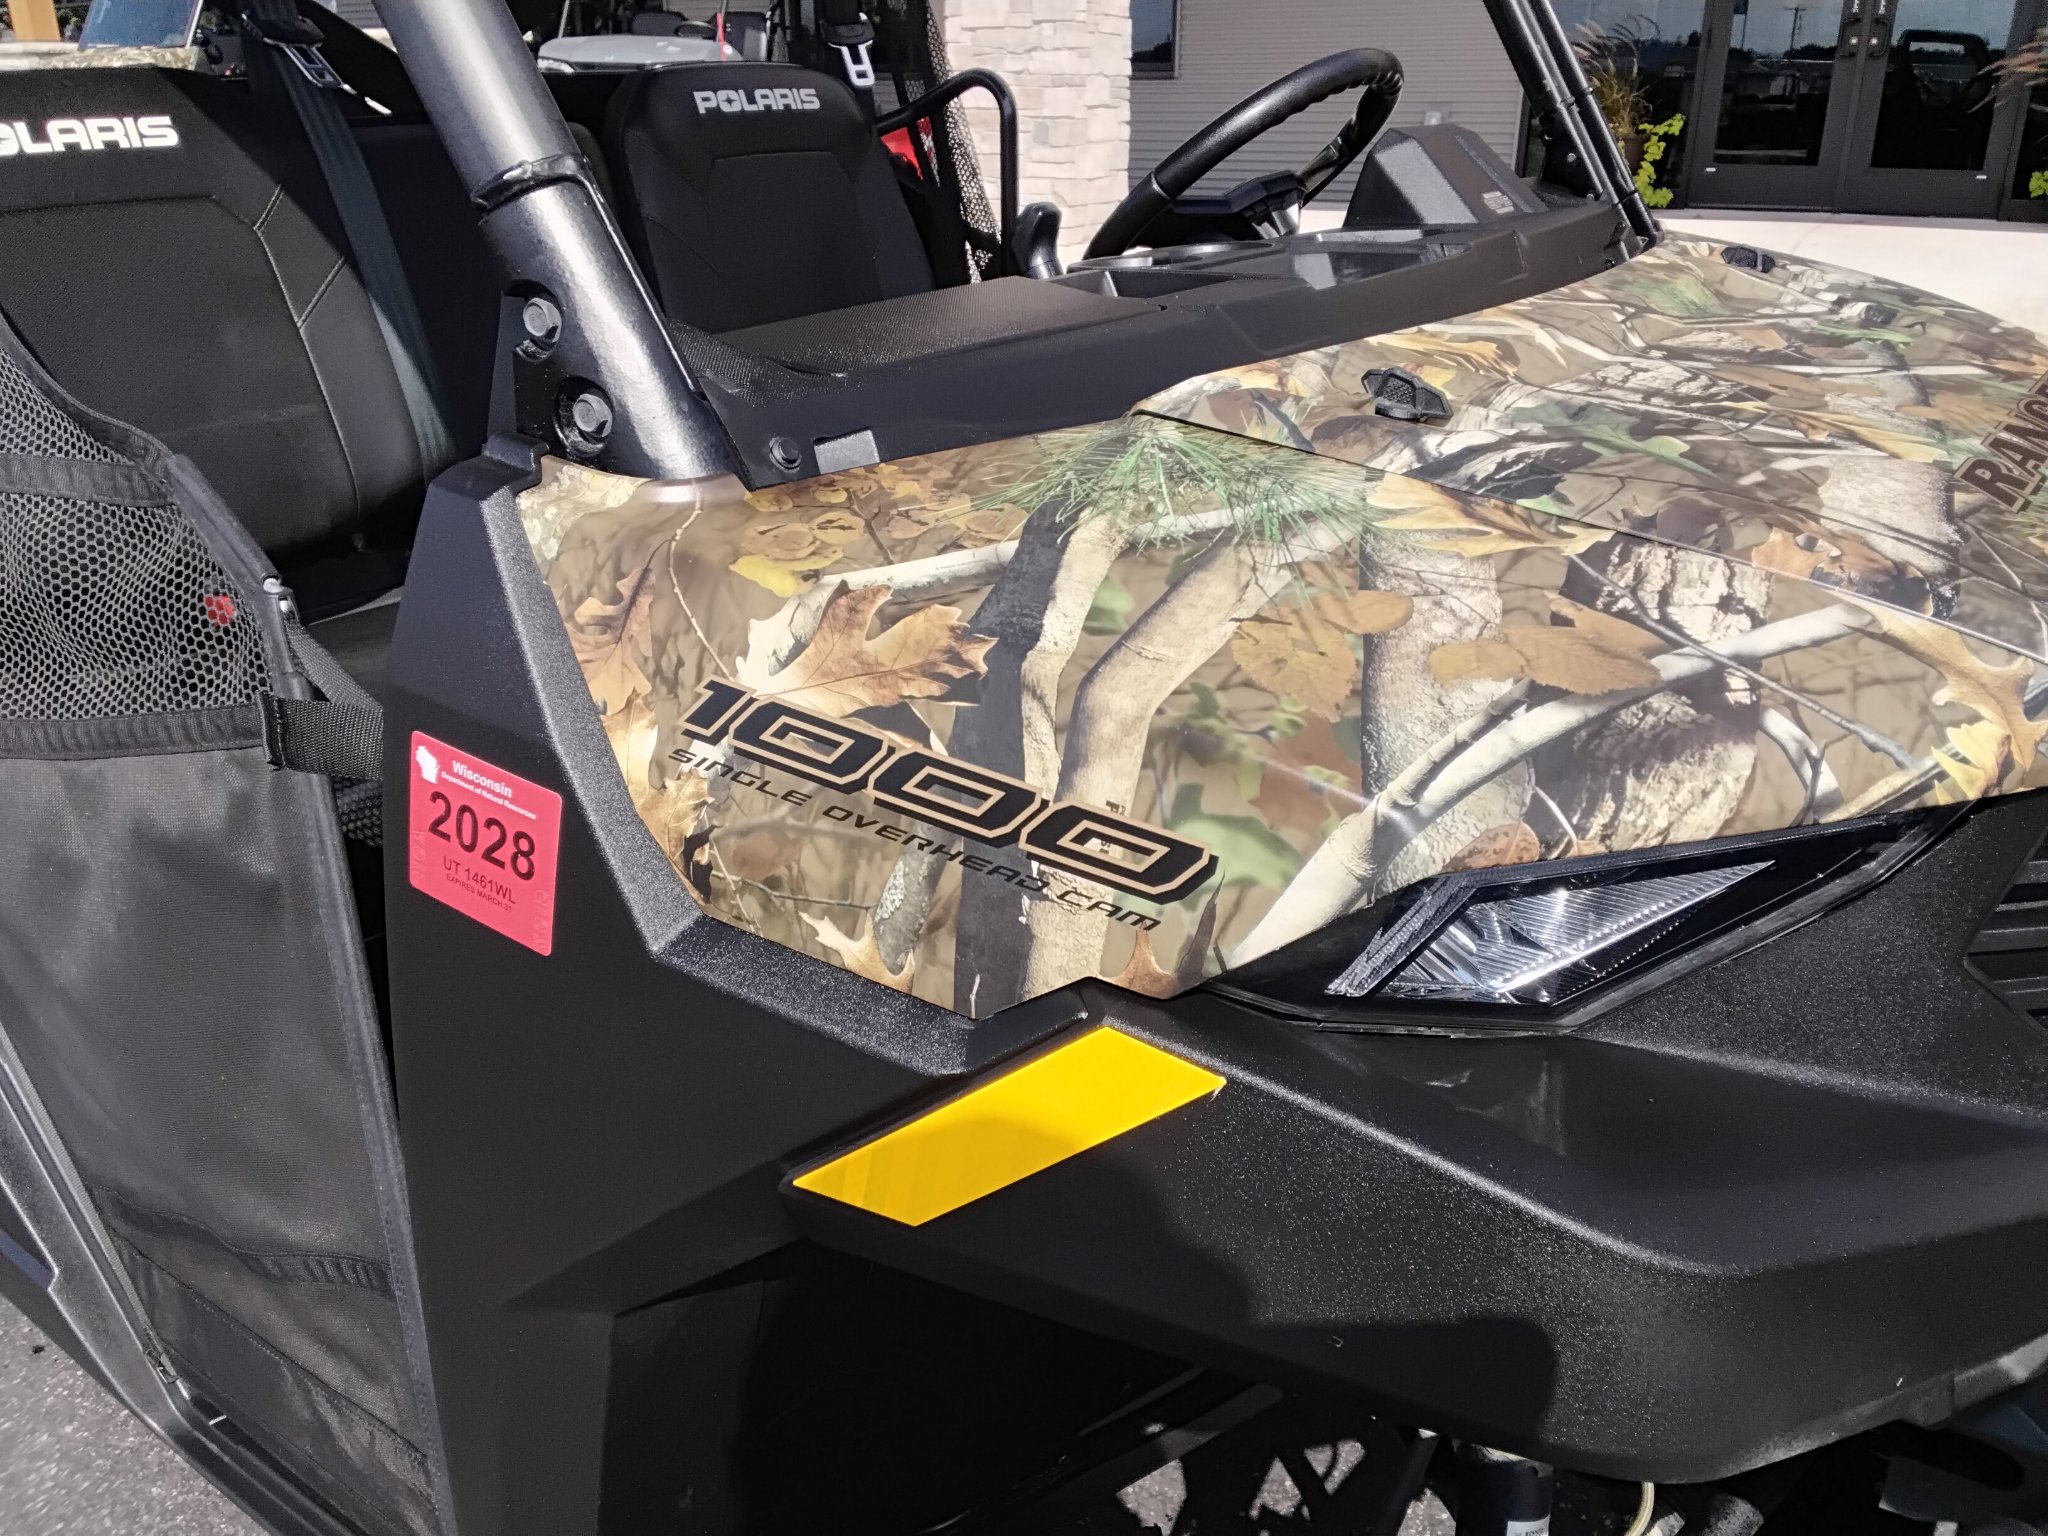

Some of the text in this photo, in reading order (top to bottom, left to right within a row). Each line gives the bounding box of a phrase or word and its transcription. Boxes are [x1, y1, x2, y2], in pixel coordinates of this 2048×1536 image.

[693, 88, 820, 114] POLARIS
[441, 771, 475, 792] Department
[481, 790, 504, 806] Natural
[503, 800, 537, 820] Resources
[452, 760, 512, 798] Wisconsin
[675, 674, 1219, 904] 1000
[428, 791, 535, 880] 2028
[668, 748, 1162, 932] SINGLE OVERHEAD CAM
[443, 856, 516, 904] UT 1461WL
[446, 873, 476, 893] EXPIRES
[477, 889, 502, 907] MARCH
